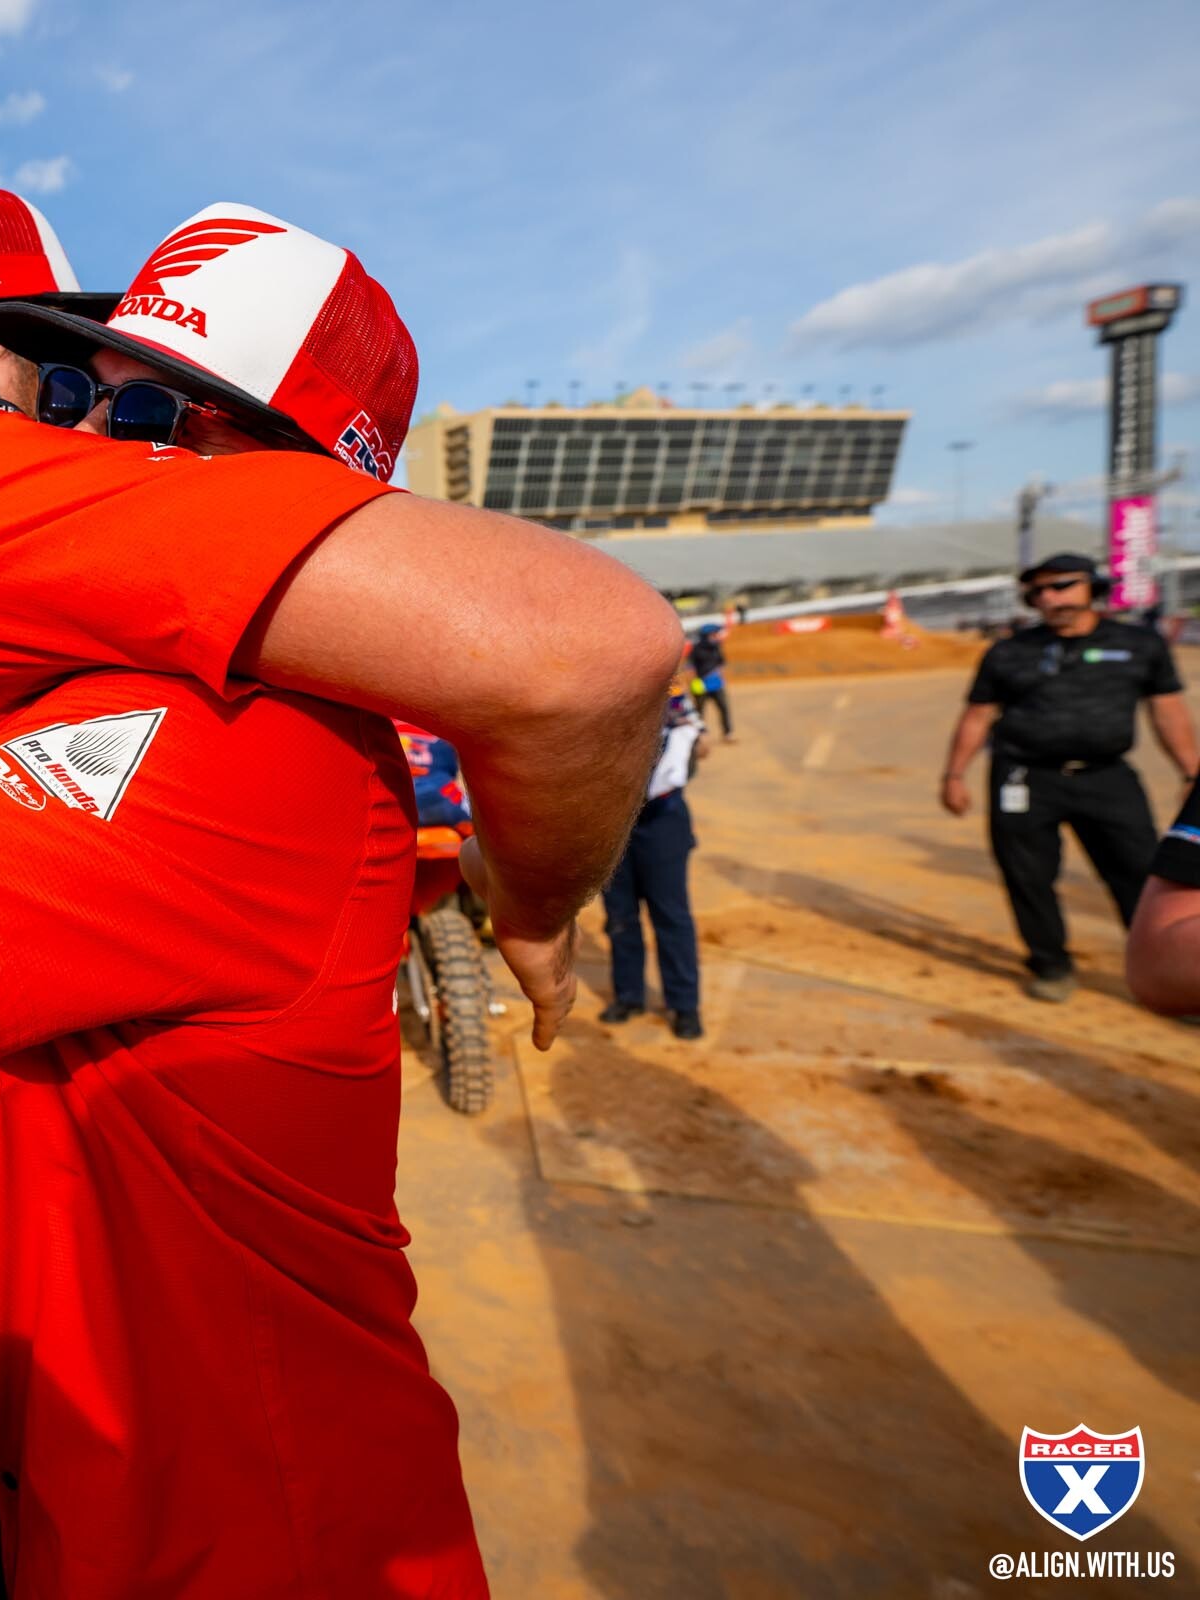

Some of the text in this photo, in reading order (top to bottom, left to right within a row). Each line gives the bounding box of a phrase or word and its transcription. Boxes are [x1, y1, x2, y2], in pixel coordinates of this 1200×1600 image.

[107, 296, 208, 338] ONDA
[22, 740, 100, 812] Pro Honda
